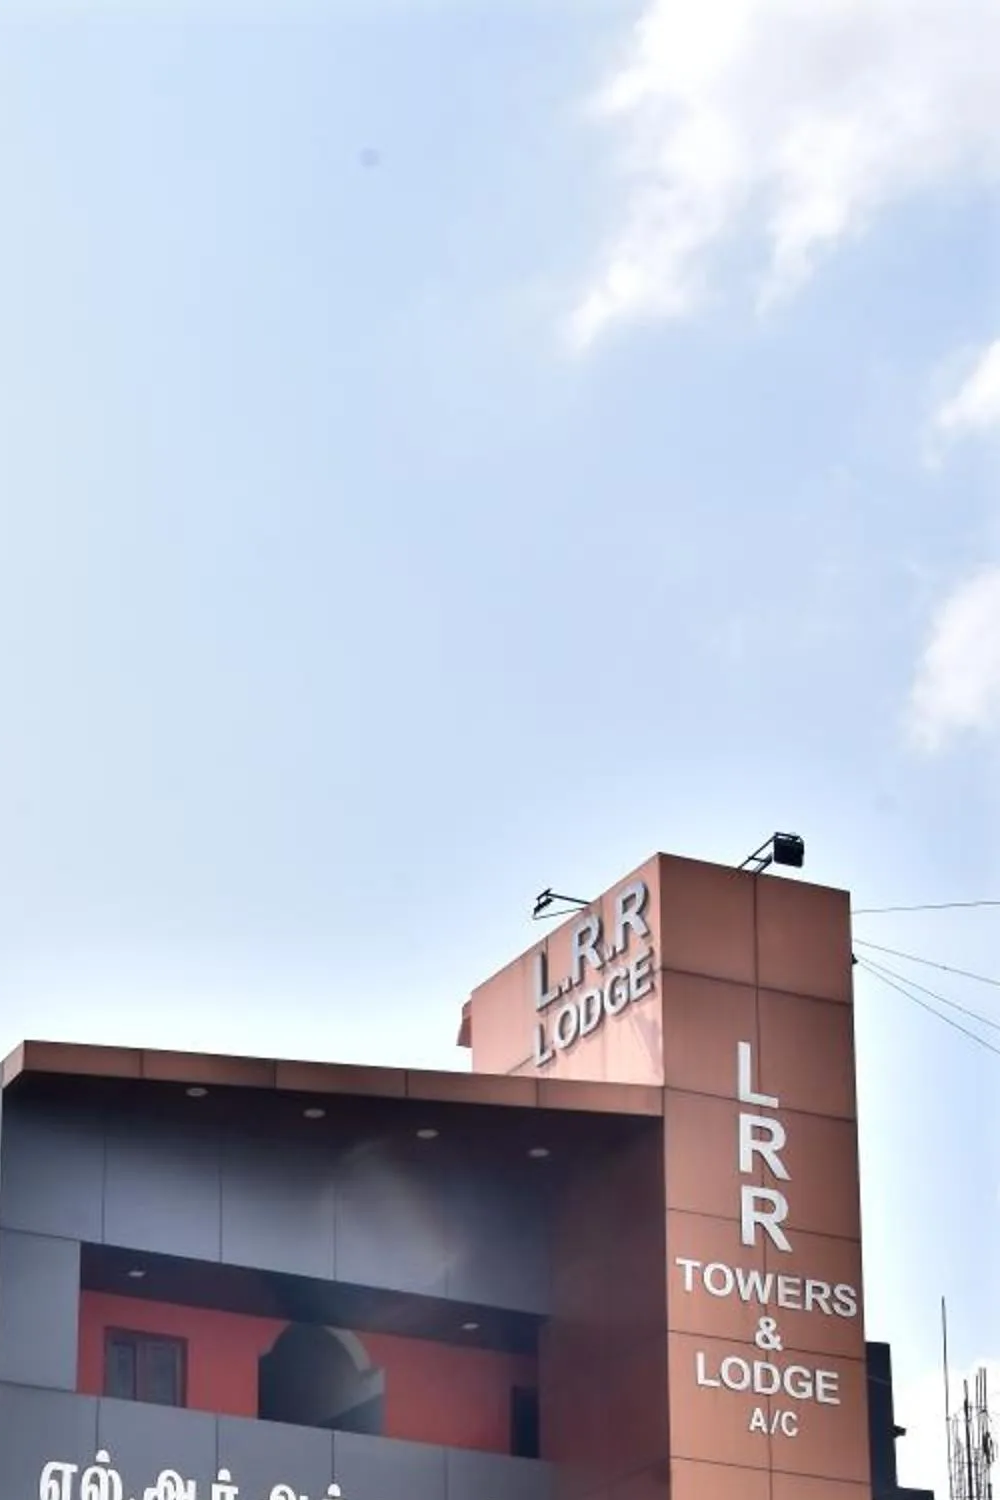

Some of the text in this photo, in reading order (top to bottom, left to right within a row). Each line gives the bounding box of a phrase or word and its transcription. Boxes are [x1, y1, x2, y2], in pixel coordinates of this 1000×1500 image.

[533, 879, 649, 1013] L.R.R
[533, 947, 656, 1068] LODGE
[675, 1258, 857, 1317] TOWERS
[755, 1317, 782, 1350] &
[696, 1352, 840, 1404] LODGE
[749, 1408, 798, 1437] A/C
